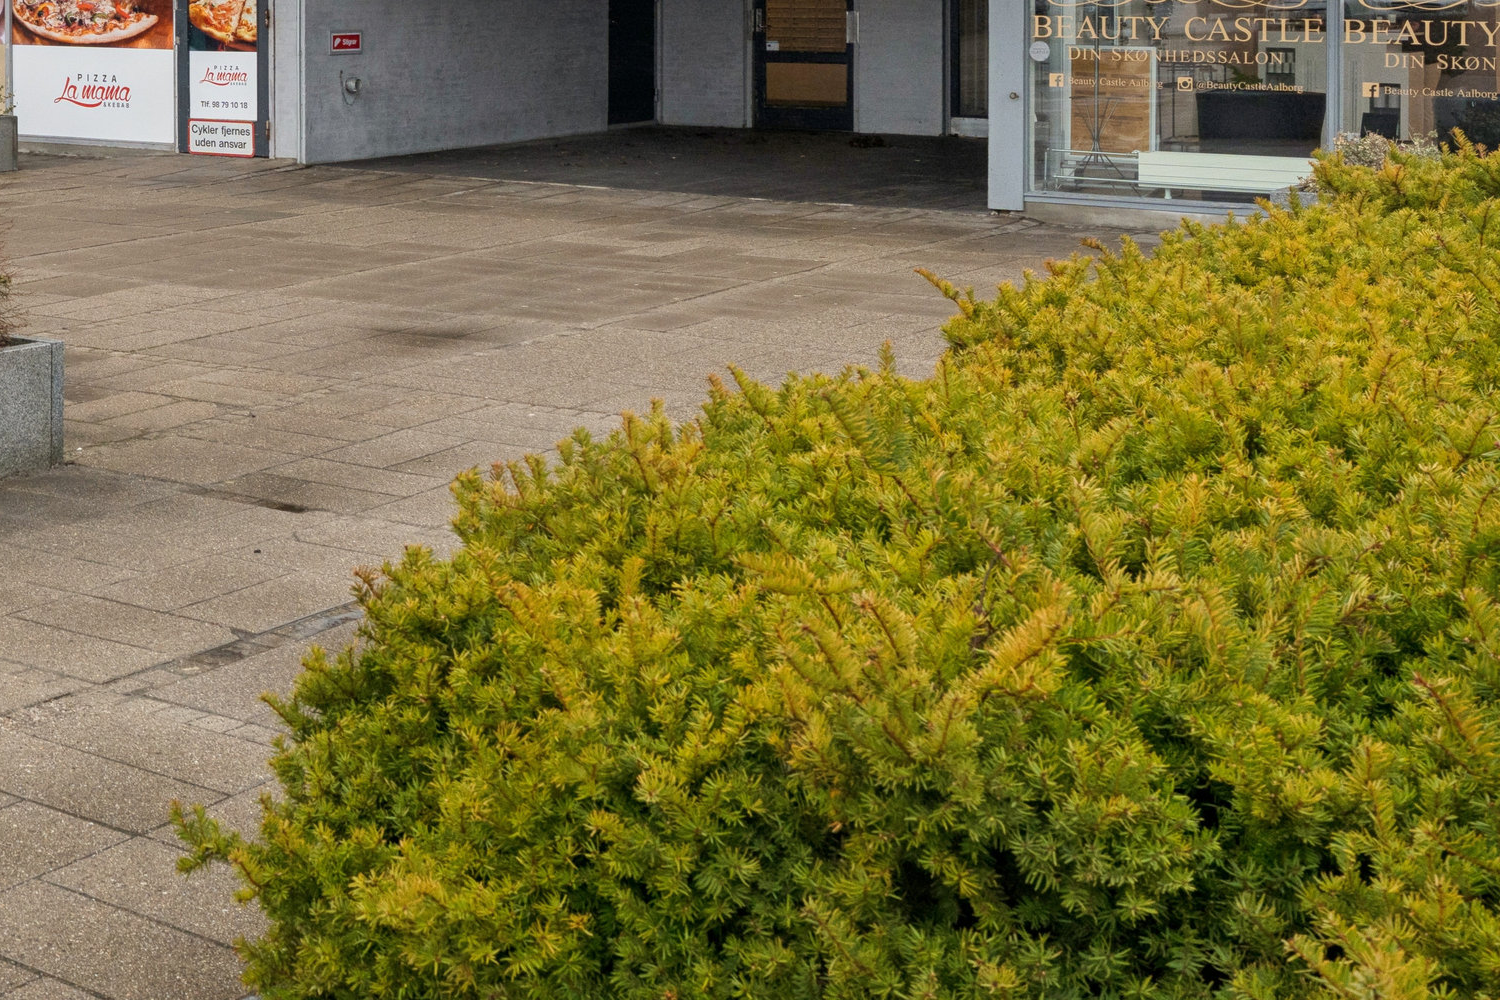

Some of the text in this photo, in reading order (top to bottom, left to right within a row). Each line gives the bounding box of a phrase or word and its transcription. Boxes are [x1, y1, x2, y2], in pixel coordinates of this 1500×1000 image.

[1032, 15, 1324, 43] BEAUTY CASTLE
[1343, 19, 1500, 47] BEAUTY
[1068, 45, 1101, 61] DIN
[1384, 52, 1425, 69] DIN
[77, 74, 117, 83] PIZZA
[216, 71, 248, 82] mama
[1069, 77, 1097, 87] Beauty
[1100, 78, 1126, 87] Castle
[1128, 79, 1164, 90] Aalbg
[1196, 81, 1304, 94] @BeautyCastleAalborg
[82, 85, 131, 102] mama
[1384, 86, 1419, 98] Beauty
[1422, 87, 1454, 97] Castle
[1457, 88, 1498, 101] Aalborg
[200, 100, 211, 108] Tlf.
[231, 101, 238, 109] 10
[191, 124, 251, 137] Cykler fjernes
[195, 138, 247, 149] uden ansvar
